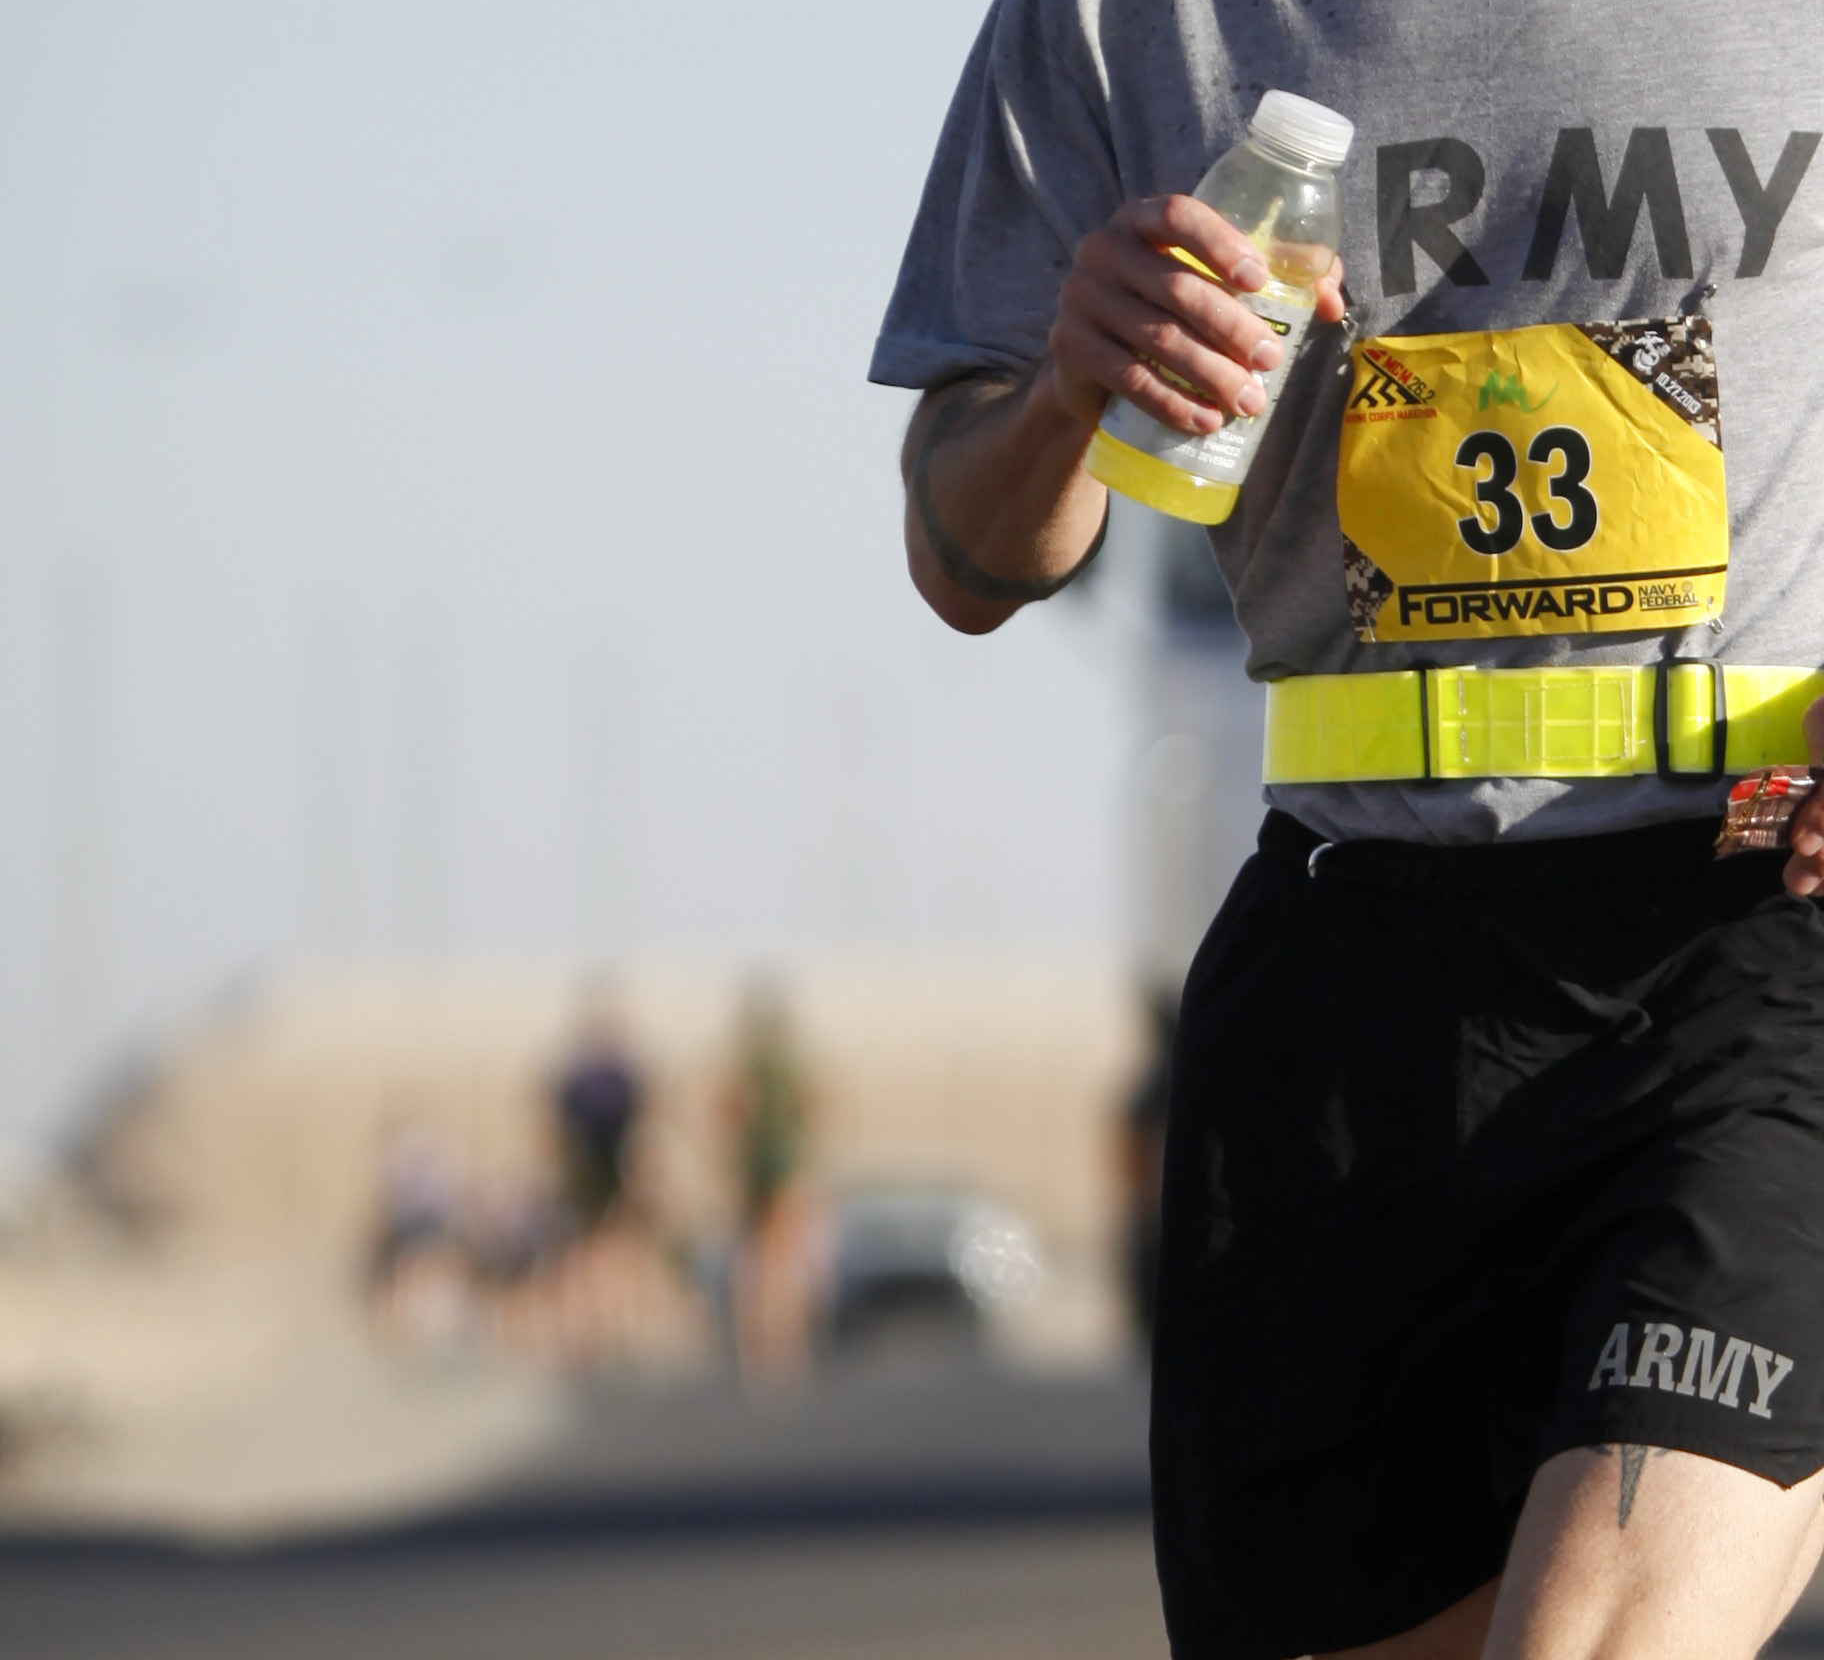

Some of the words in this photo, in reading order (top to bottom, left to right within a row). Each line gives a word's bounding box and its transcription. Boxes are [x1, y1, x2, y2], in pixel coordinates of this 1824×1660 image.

[1341, 126, 1824, 305] RMY
[1382, 355, 1413, 385] MCM
[1655, 372, 1702, 415] 10.27.2013
[1368, 411, 1395, 422] CORPS
[1397, 407, 1437, 419] MARATHON
[1197, 450, 1236, 469] BEVERAGE
[1453, 423, 1600, 558] 33
[1397, 585, 1634, 626] FORWARD
[1638, 582, 1677, 597] NAVY
[1639, 593, 1699, 609] FEDERAL
[1586, 1322, 1795, 1420] ARMY
